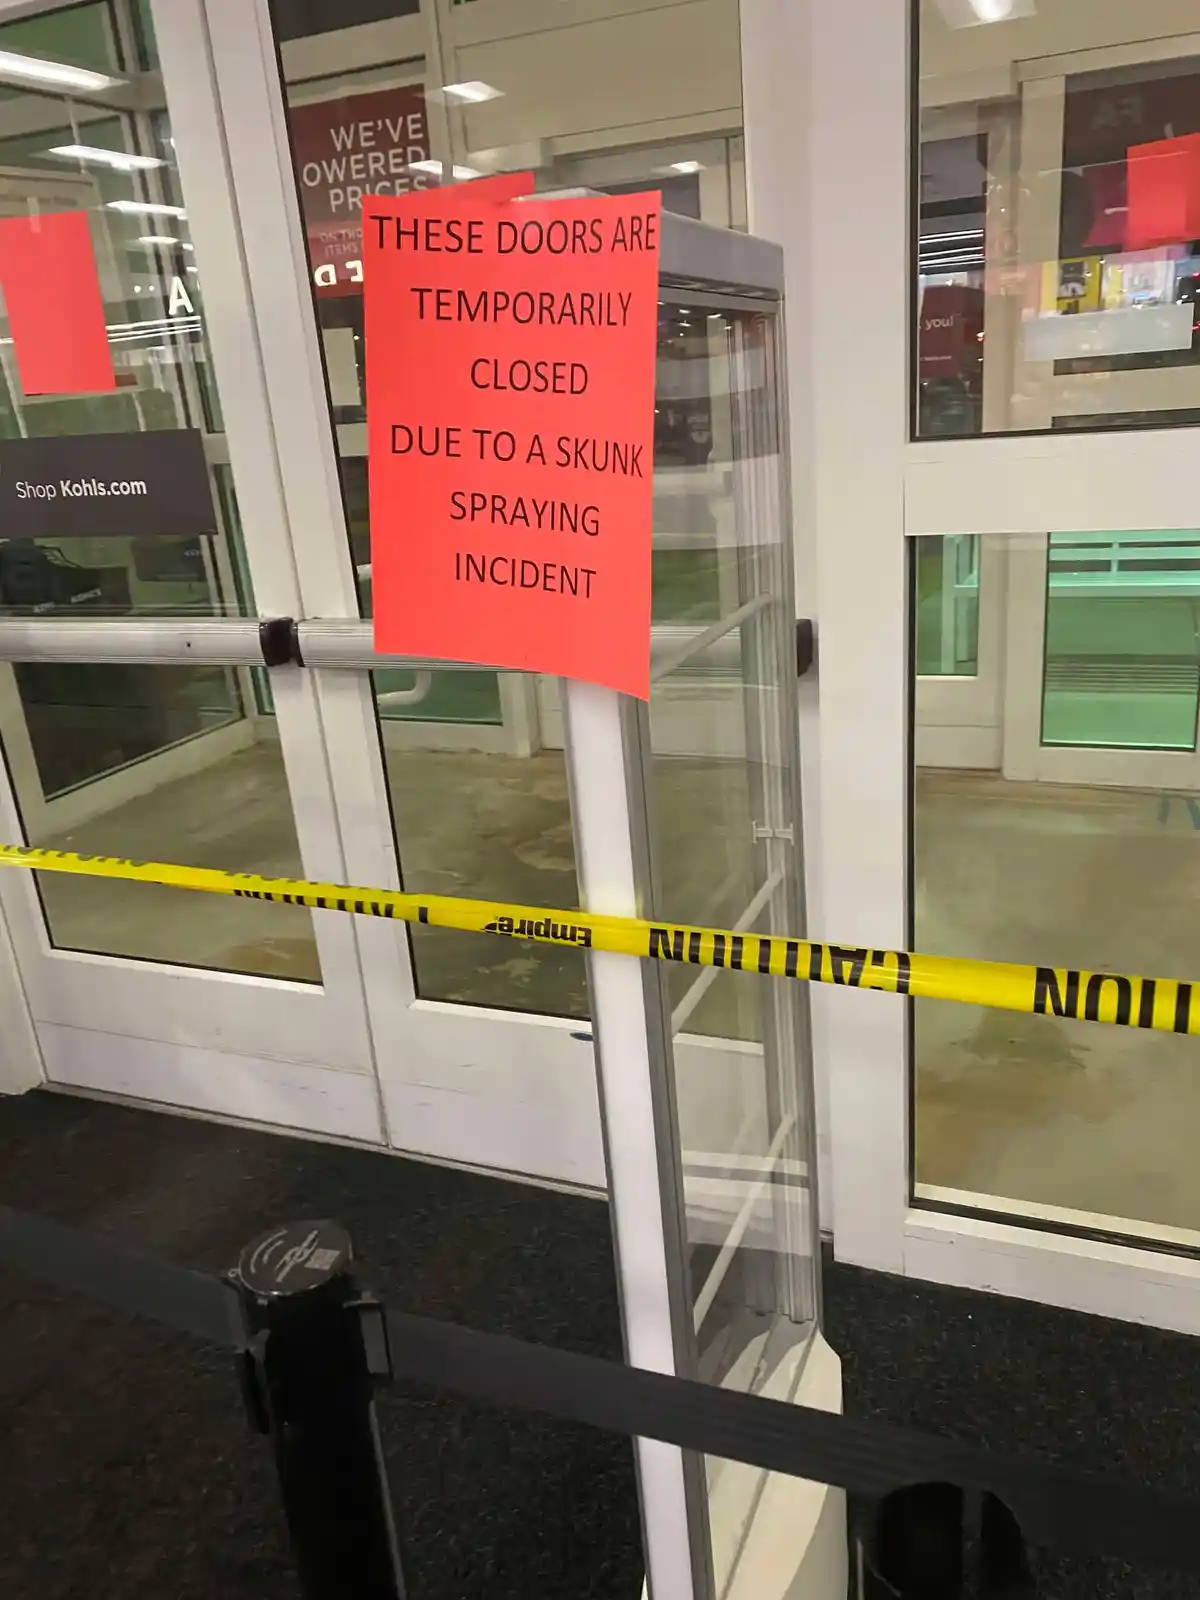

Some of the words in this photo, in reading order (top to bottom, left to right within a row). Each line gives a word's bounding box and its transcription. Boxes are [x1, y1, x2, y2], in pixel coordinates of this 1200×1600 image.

[369, 215, 483, 253] THESE
[497, 218, 602, 254] DOORS
[611, 213, 656, 252] ARE
[410, 288, 632, 326] TEMPORARILY
[471, 358, 588, 394] CLOSED
[391, 424, 461, 457] DUE
[472, 429, 516, 461] TO
[526, 434, 547, 465] A
[556, 436, 643, 478] SKUNK
[15, 481, 56, 500] Shop
[60, 478, 147, 497] Kohls.com
[450, 491, 600, 536] SPRAYING
[455, 552, 596, 599] INCIDENT
[497, 915, 592, 947] Empire
